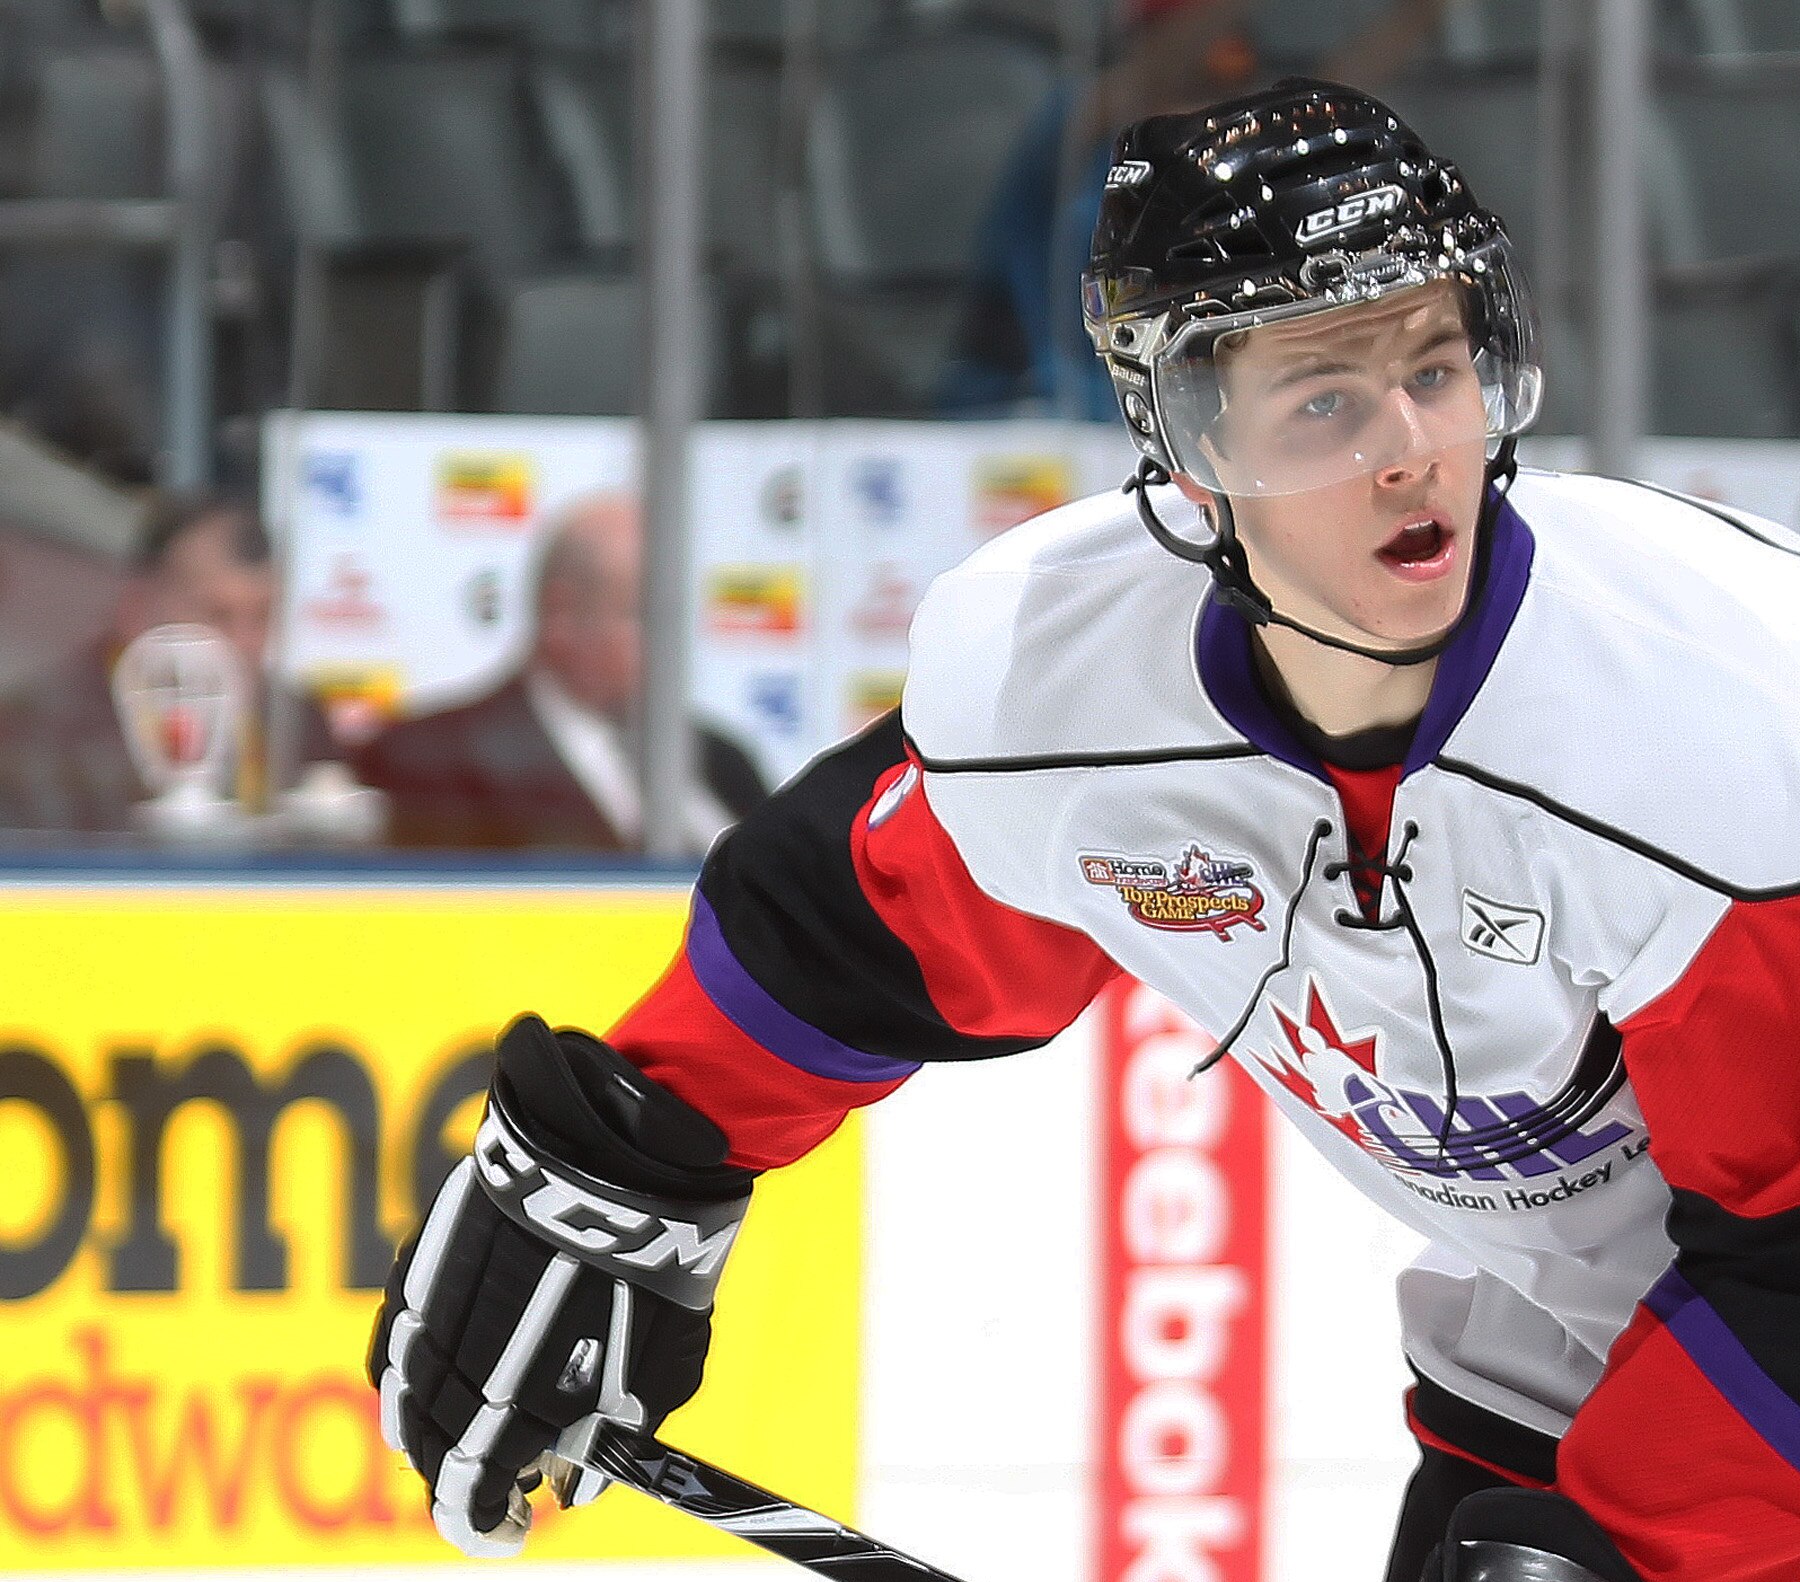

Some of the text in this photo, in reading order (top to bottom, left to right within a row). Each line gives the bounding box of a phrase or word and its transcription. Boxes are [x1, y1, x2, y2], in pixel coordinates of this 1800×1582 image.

[1306, 193, 1394, 232] CCM
[1120, 886, 1250, 914] Top Prospects
[1140, 902, 1197, 920] GAME
[1344, 1072, 1634, 1181] CHL
[475, 1100, 742, 1276] CCM
[1393, 1172, 1498, 1211] nadian
[1504, 1160, 1613, 1212] Hockey
